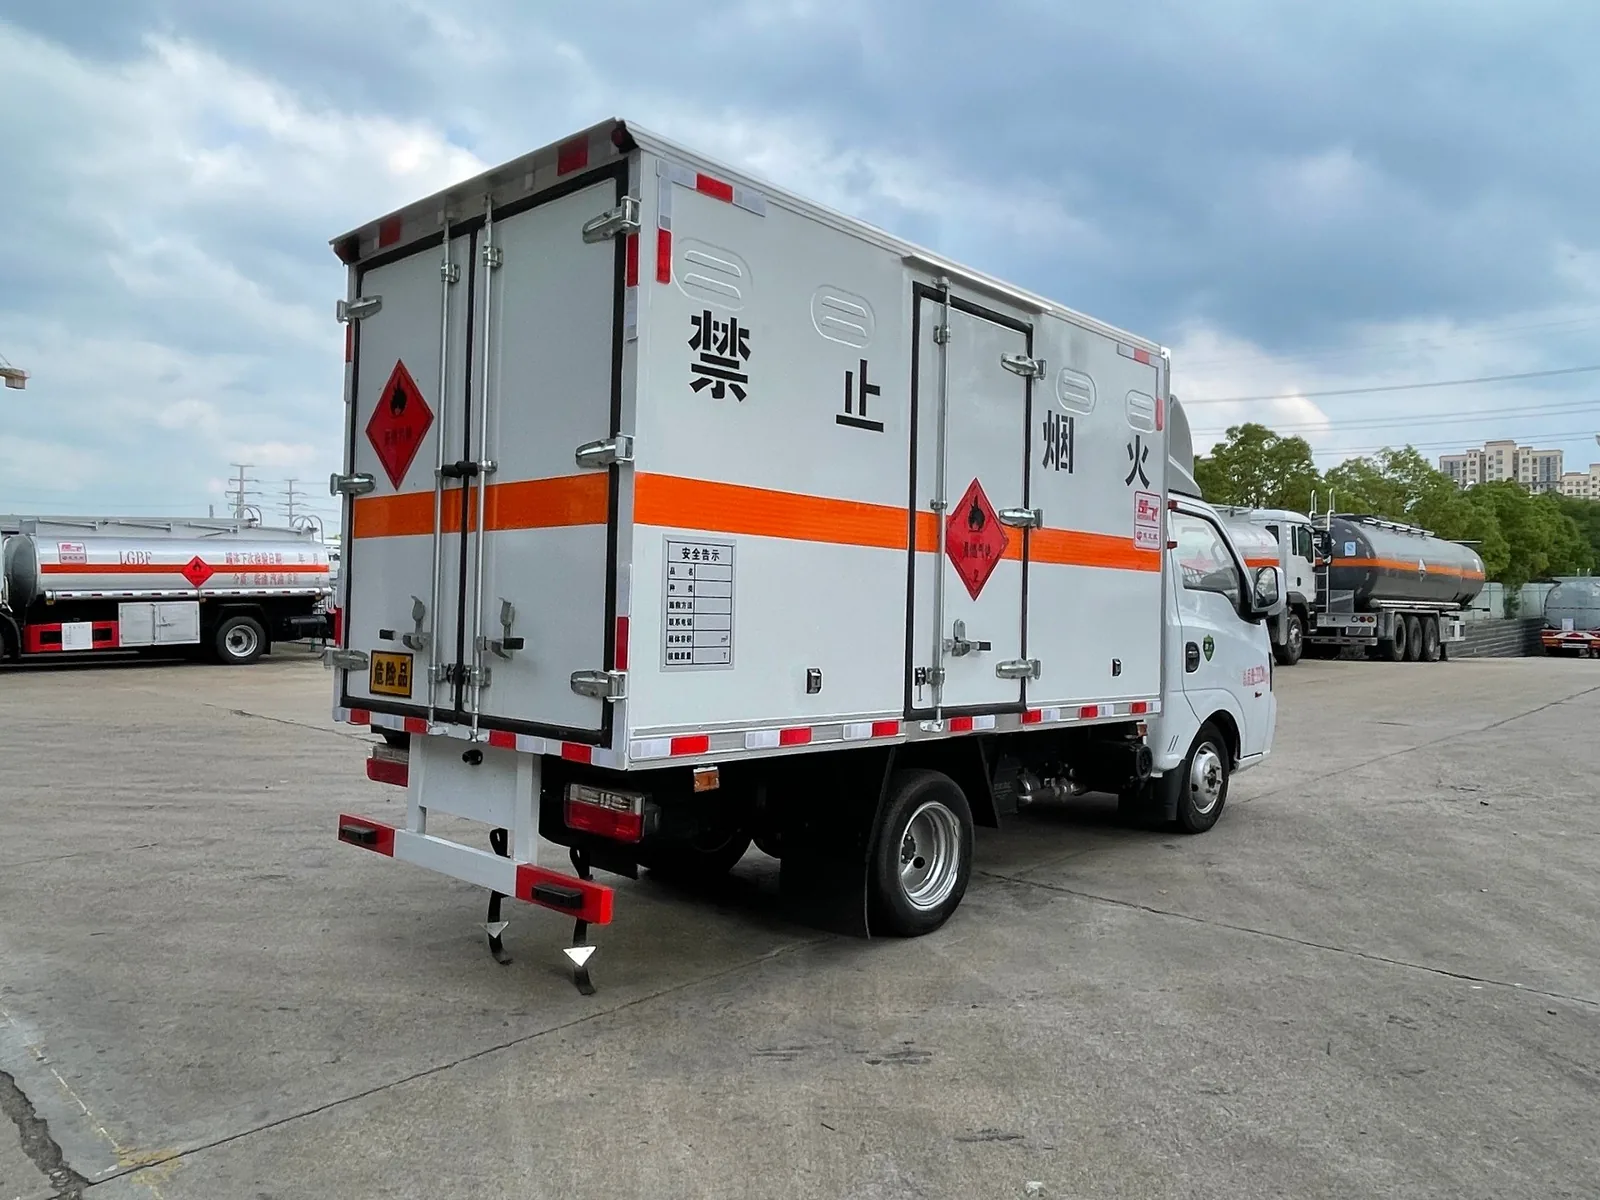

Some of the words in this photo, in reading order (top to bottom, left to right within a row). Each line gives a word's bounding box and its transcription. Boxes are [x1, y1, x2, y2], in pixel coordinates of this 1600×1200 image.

[682, 547, 720, 562] 安全告示
[374, 660, 408, 688] 危险品
